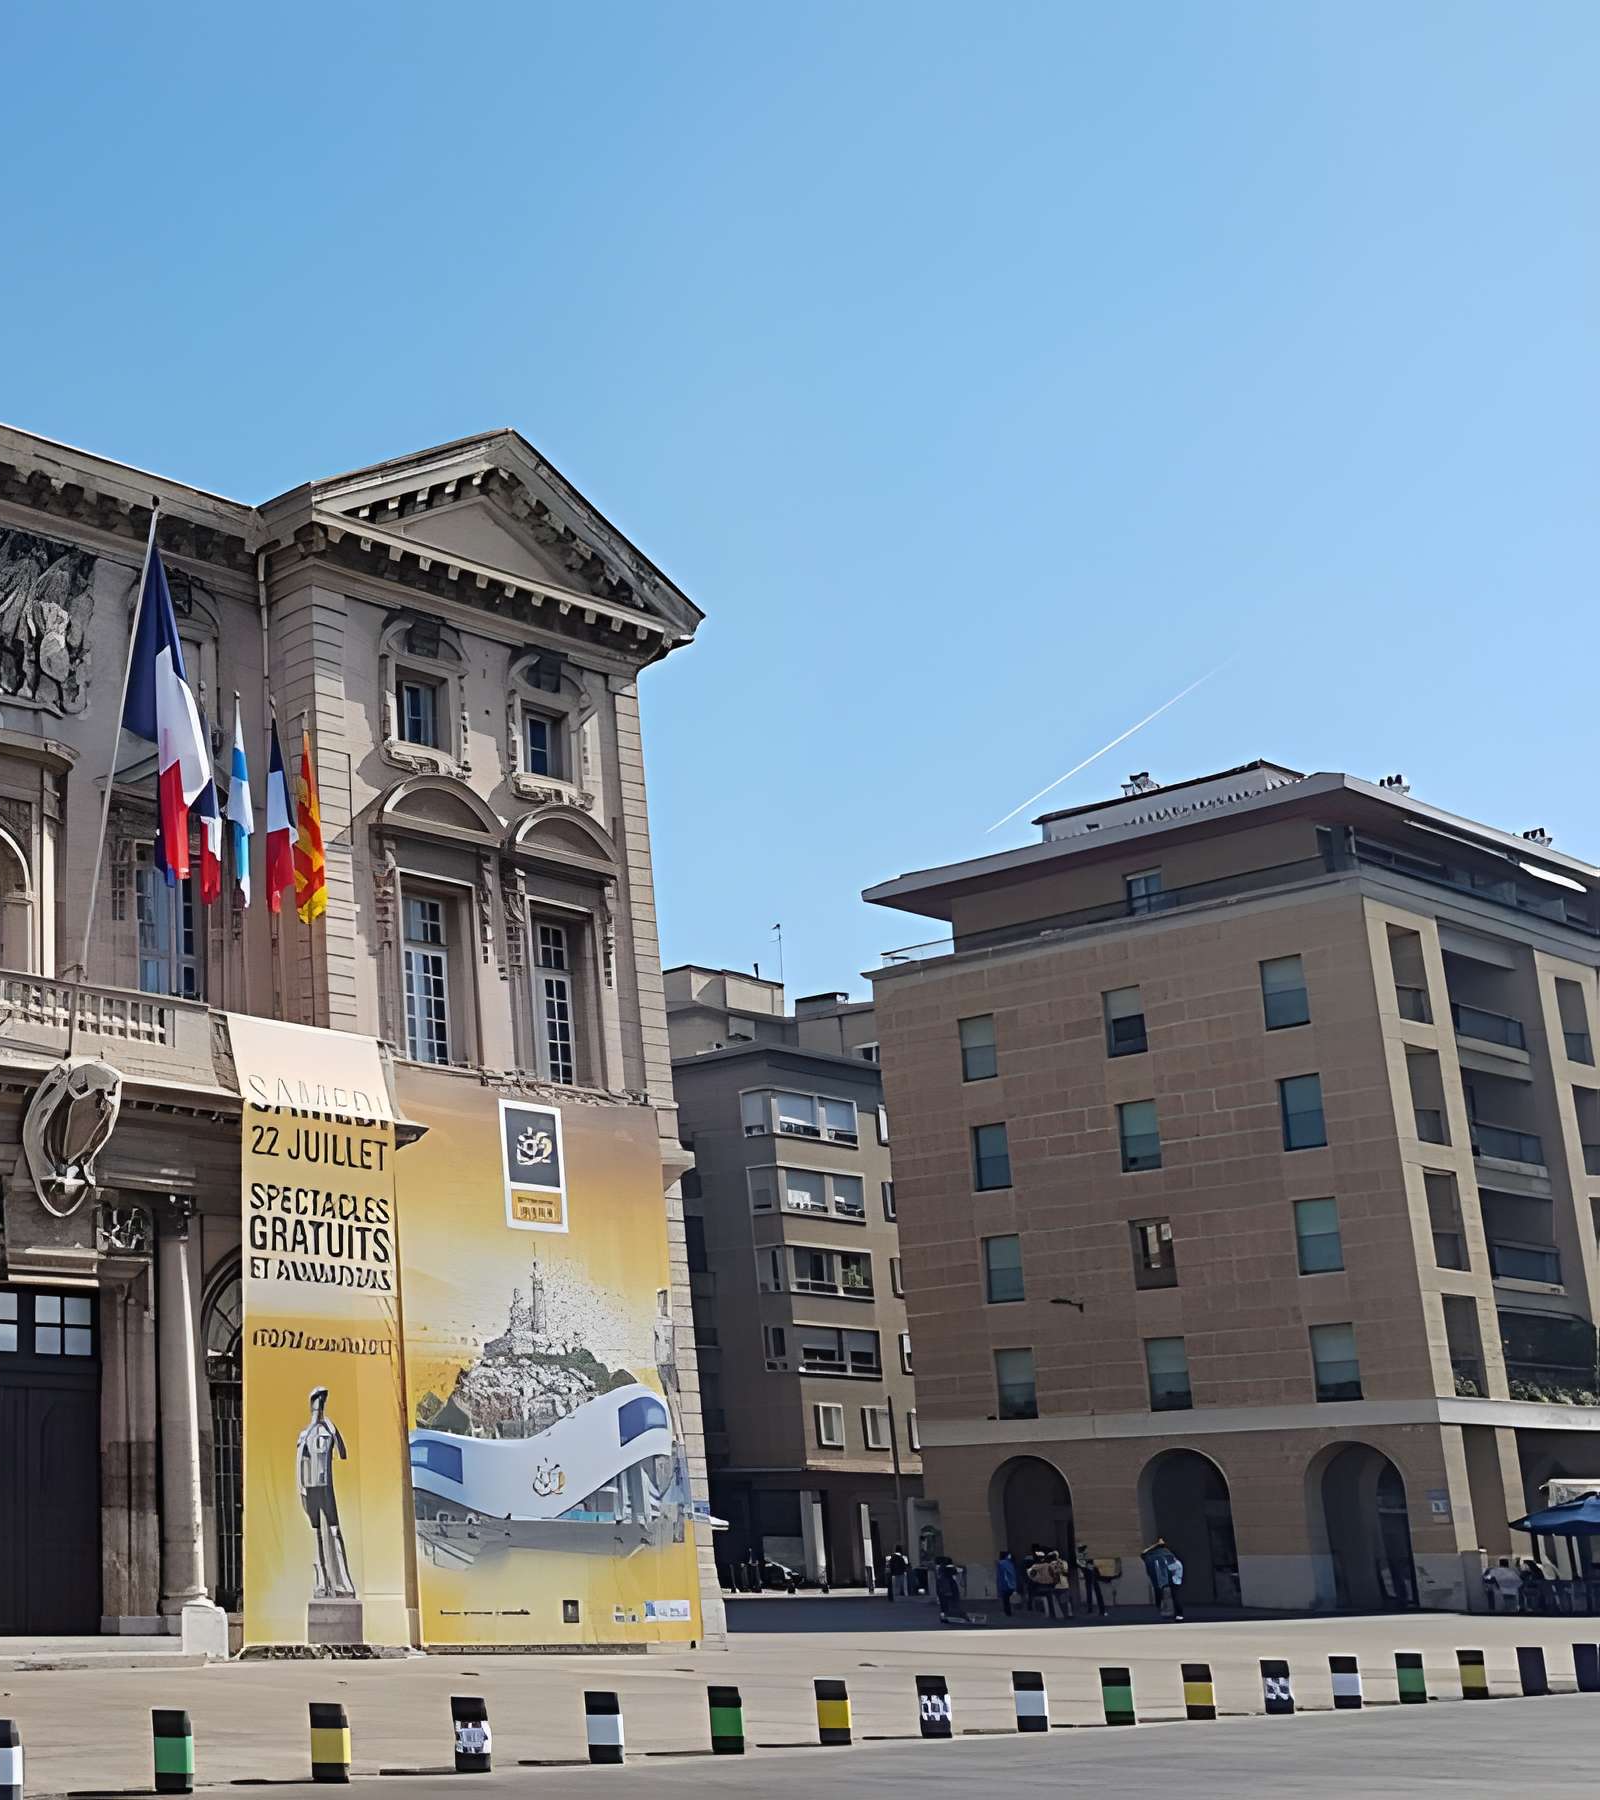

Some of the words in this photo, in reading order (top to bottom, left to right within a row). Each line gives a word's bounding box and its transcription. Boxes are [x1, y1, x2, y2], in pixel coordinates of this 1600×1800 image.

[250, 1125, 280, 1157] 22
[286, 1128, 389, 1172] JUILLET
[249, 1182, 391, 1225] SPECTACLES
[249, 1214, 393, 1264] GRATUITS
